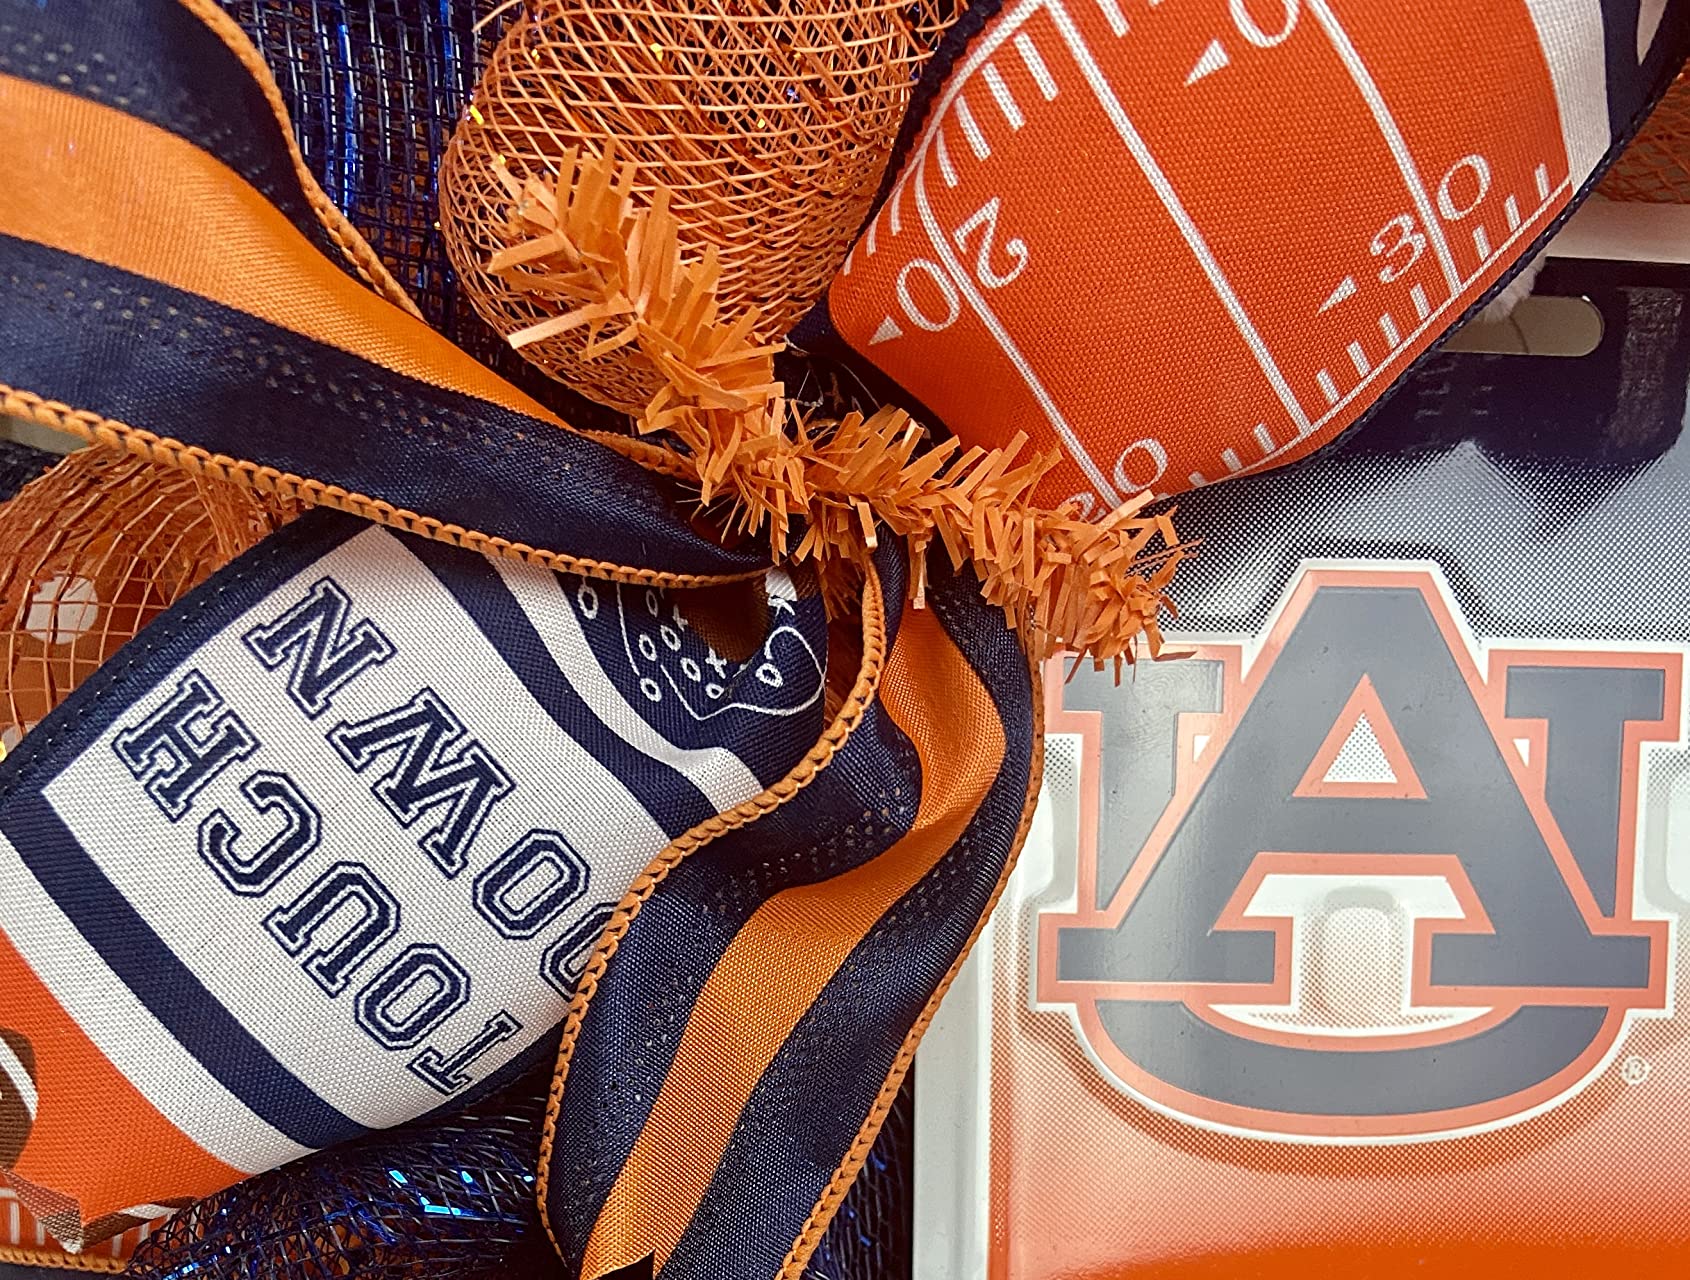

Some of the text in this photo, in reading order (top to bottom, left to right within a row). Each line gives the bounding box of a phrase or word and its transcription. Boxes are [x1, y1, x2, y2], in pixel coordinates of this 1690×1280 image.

[896, 197, 1029, 332] 20
[1369, 154, 1491, 284] 30
[115, 669, 520, 1094] TOUCH
